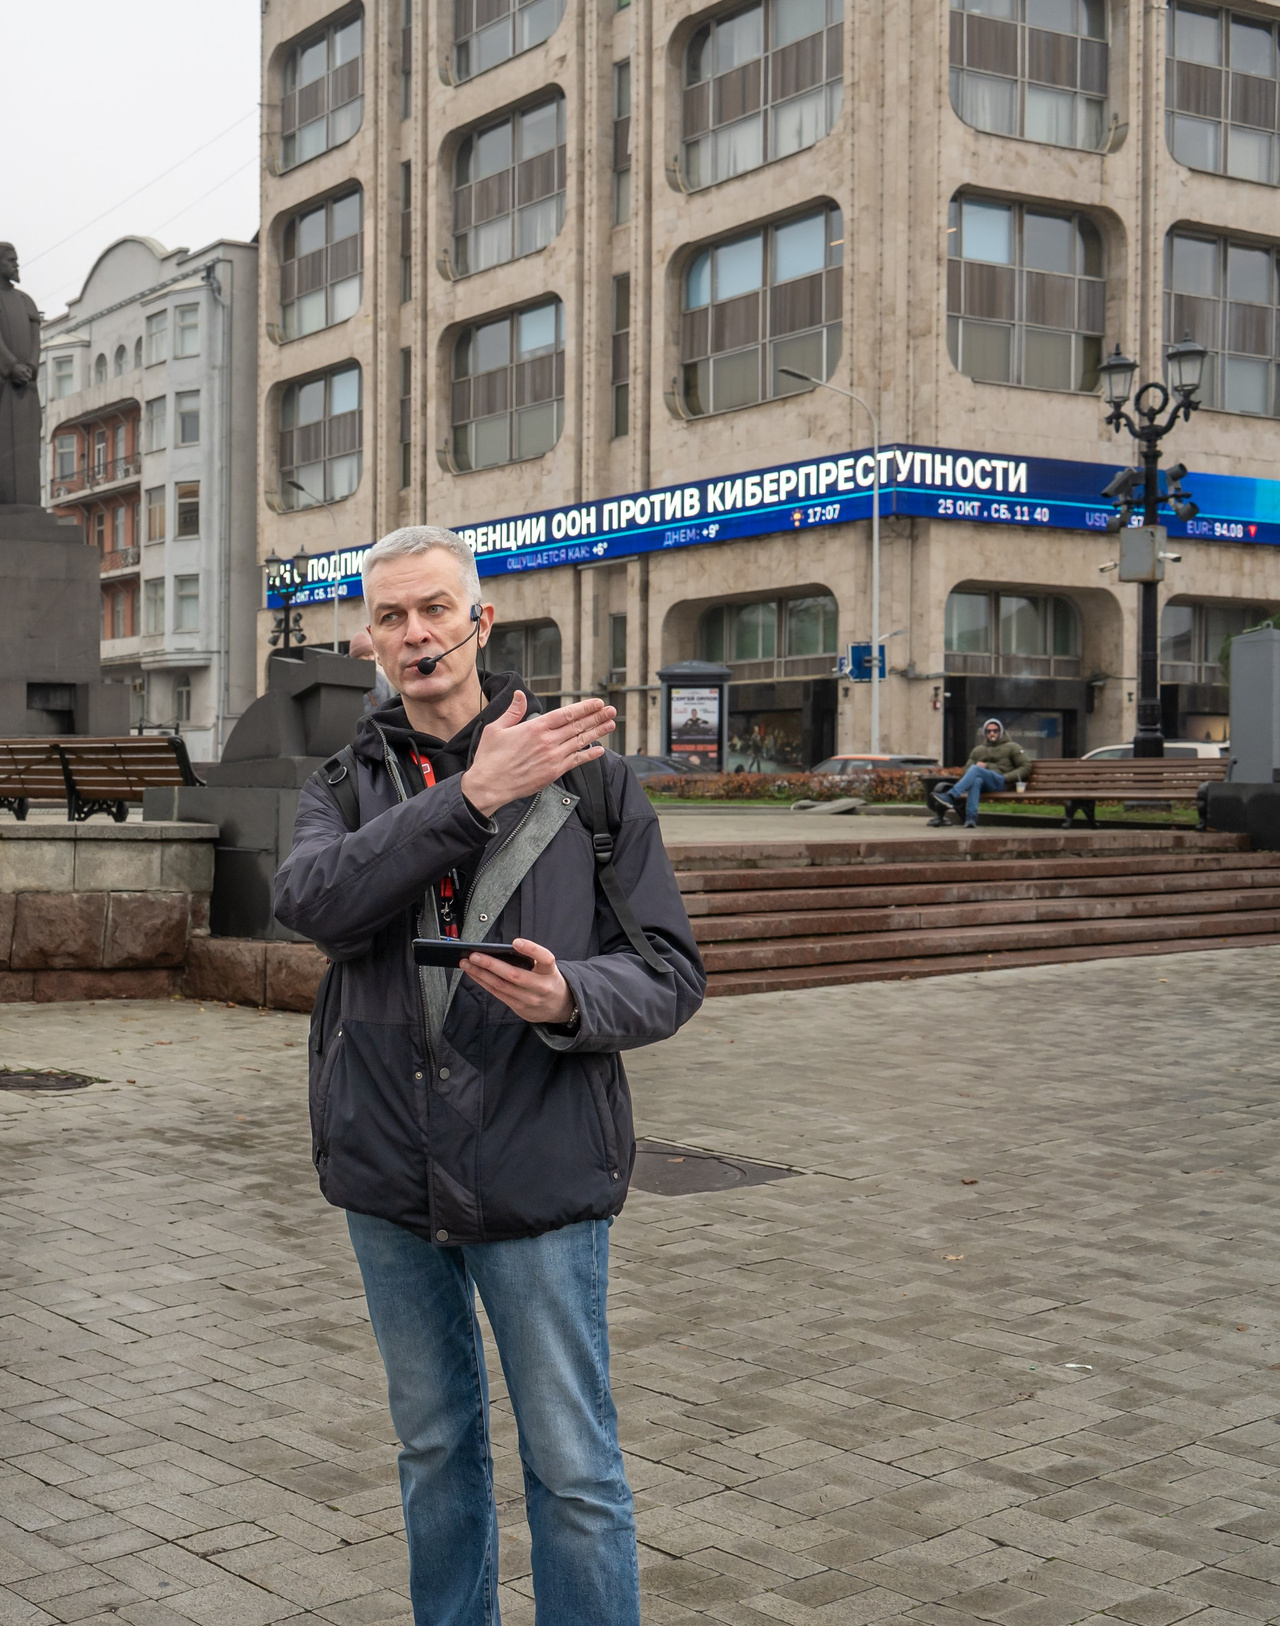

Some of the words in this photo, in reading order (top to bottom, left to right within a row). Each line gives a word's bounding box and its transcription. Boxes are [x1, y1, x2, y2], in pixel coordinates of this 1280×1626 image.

[458, 515, 546, 552] ВЕНЦИИ
[552, 506, 596, 539] ООН
[603, 487, 700, 531] ПРОТИВ
[707, 450, 1027, 513] КИБЕРПРЕСТУПНОСТИ
[938, 498, 954, 514] 25
[807, 504, 841, 523] 17:07
[663, 527, 701, 547] ДНЕМ:
[1187, 520, 1213, 535] EUR:
[1214, 522, 1244, 538] 94.08
[507, 548, 566, 570] ОЩУЩАЕТСЯ
[568, 546, 590, 560] КАК:
